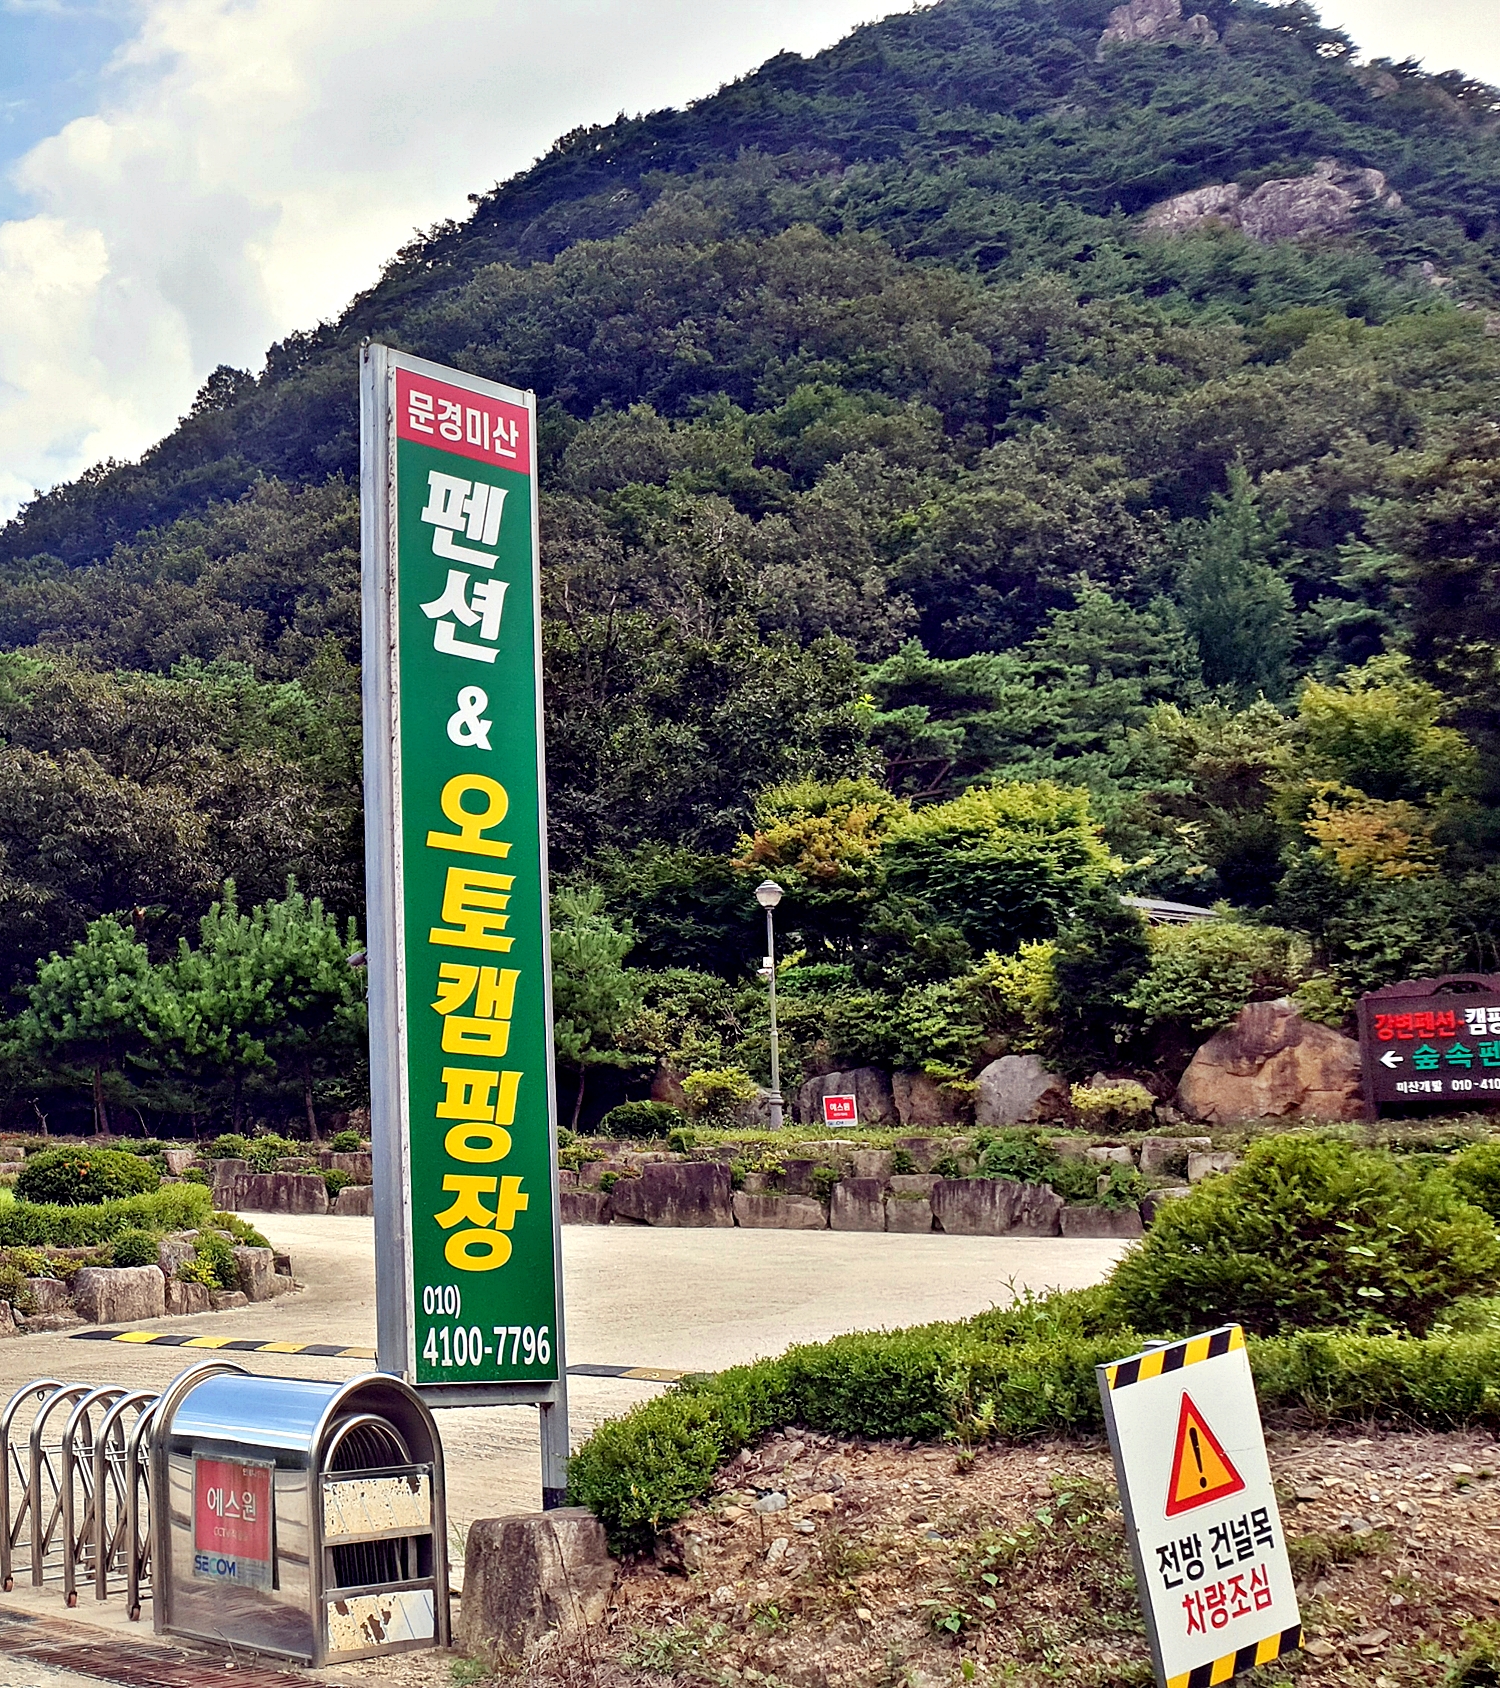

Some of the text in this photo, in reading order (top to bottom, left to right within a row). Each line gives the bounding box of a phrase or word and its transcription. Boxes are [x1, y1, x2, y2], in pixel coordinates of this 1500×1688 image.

[408, 389, 520, 459] 문경미산
[419, 469, 529, 1272] 펜션 & 오토캠핑장
[423, 1284, 461, 1319] 010)
[423, 1325, 551, 1367] 4100-7796
[206, 1487, 257, 1522] 에스원
[194, 1554, 236, 1577] SECOM
[1155, 1506, 1275, 1590] 전방 건널목
[1182, 1563, 1273, 1636] 차량조심
